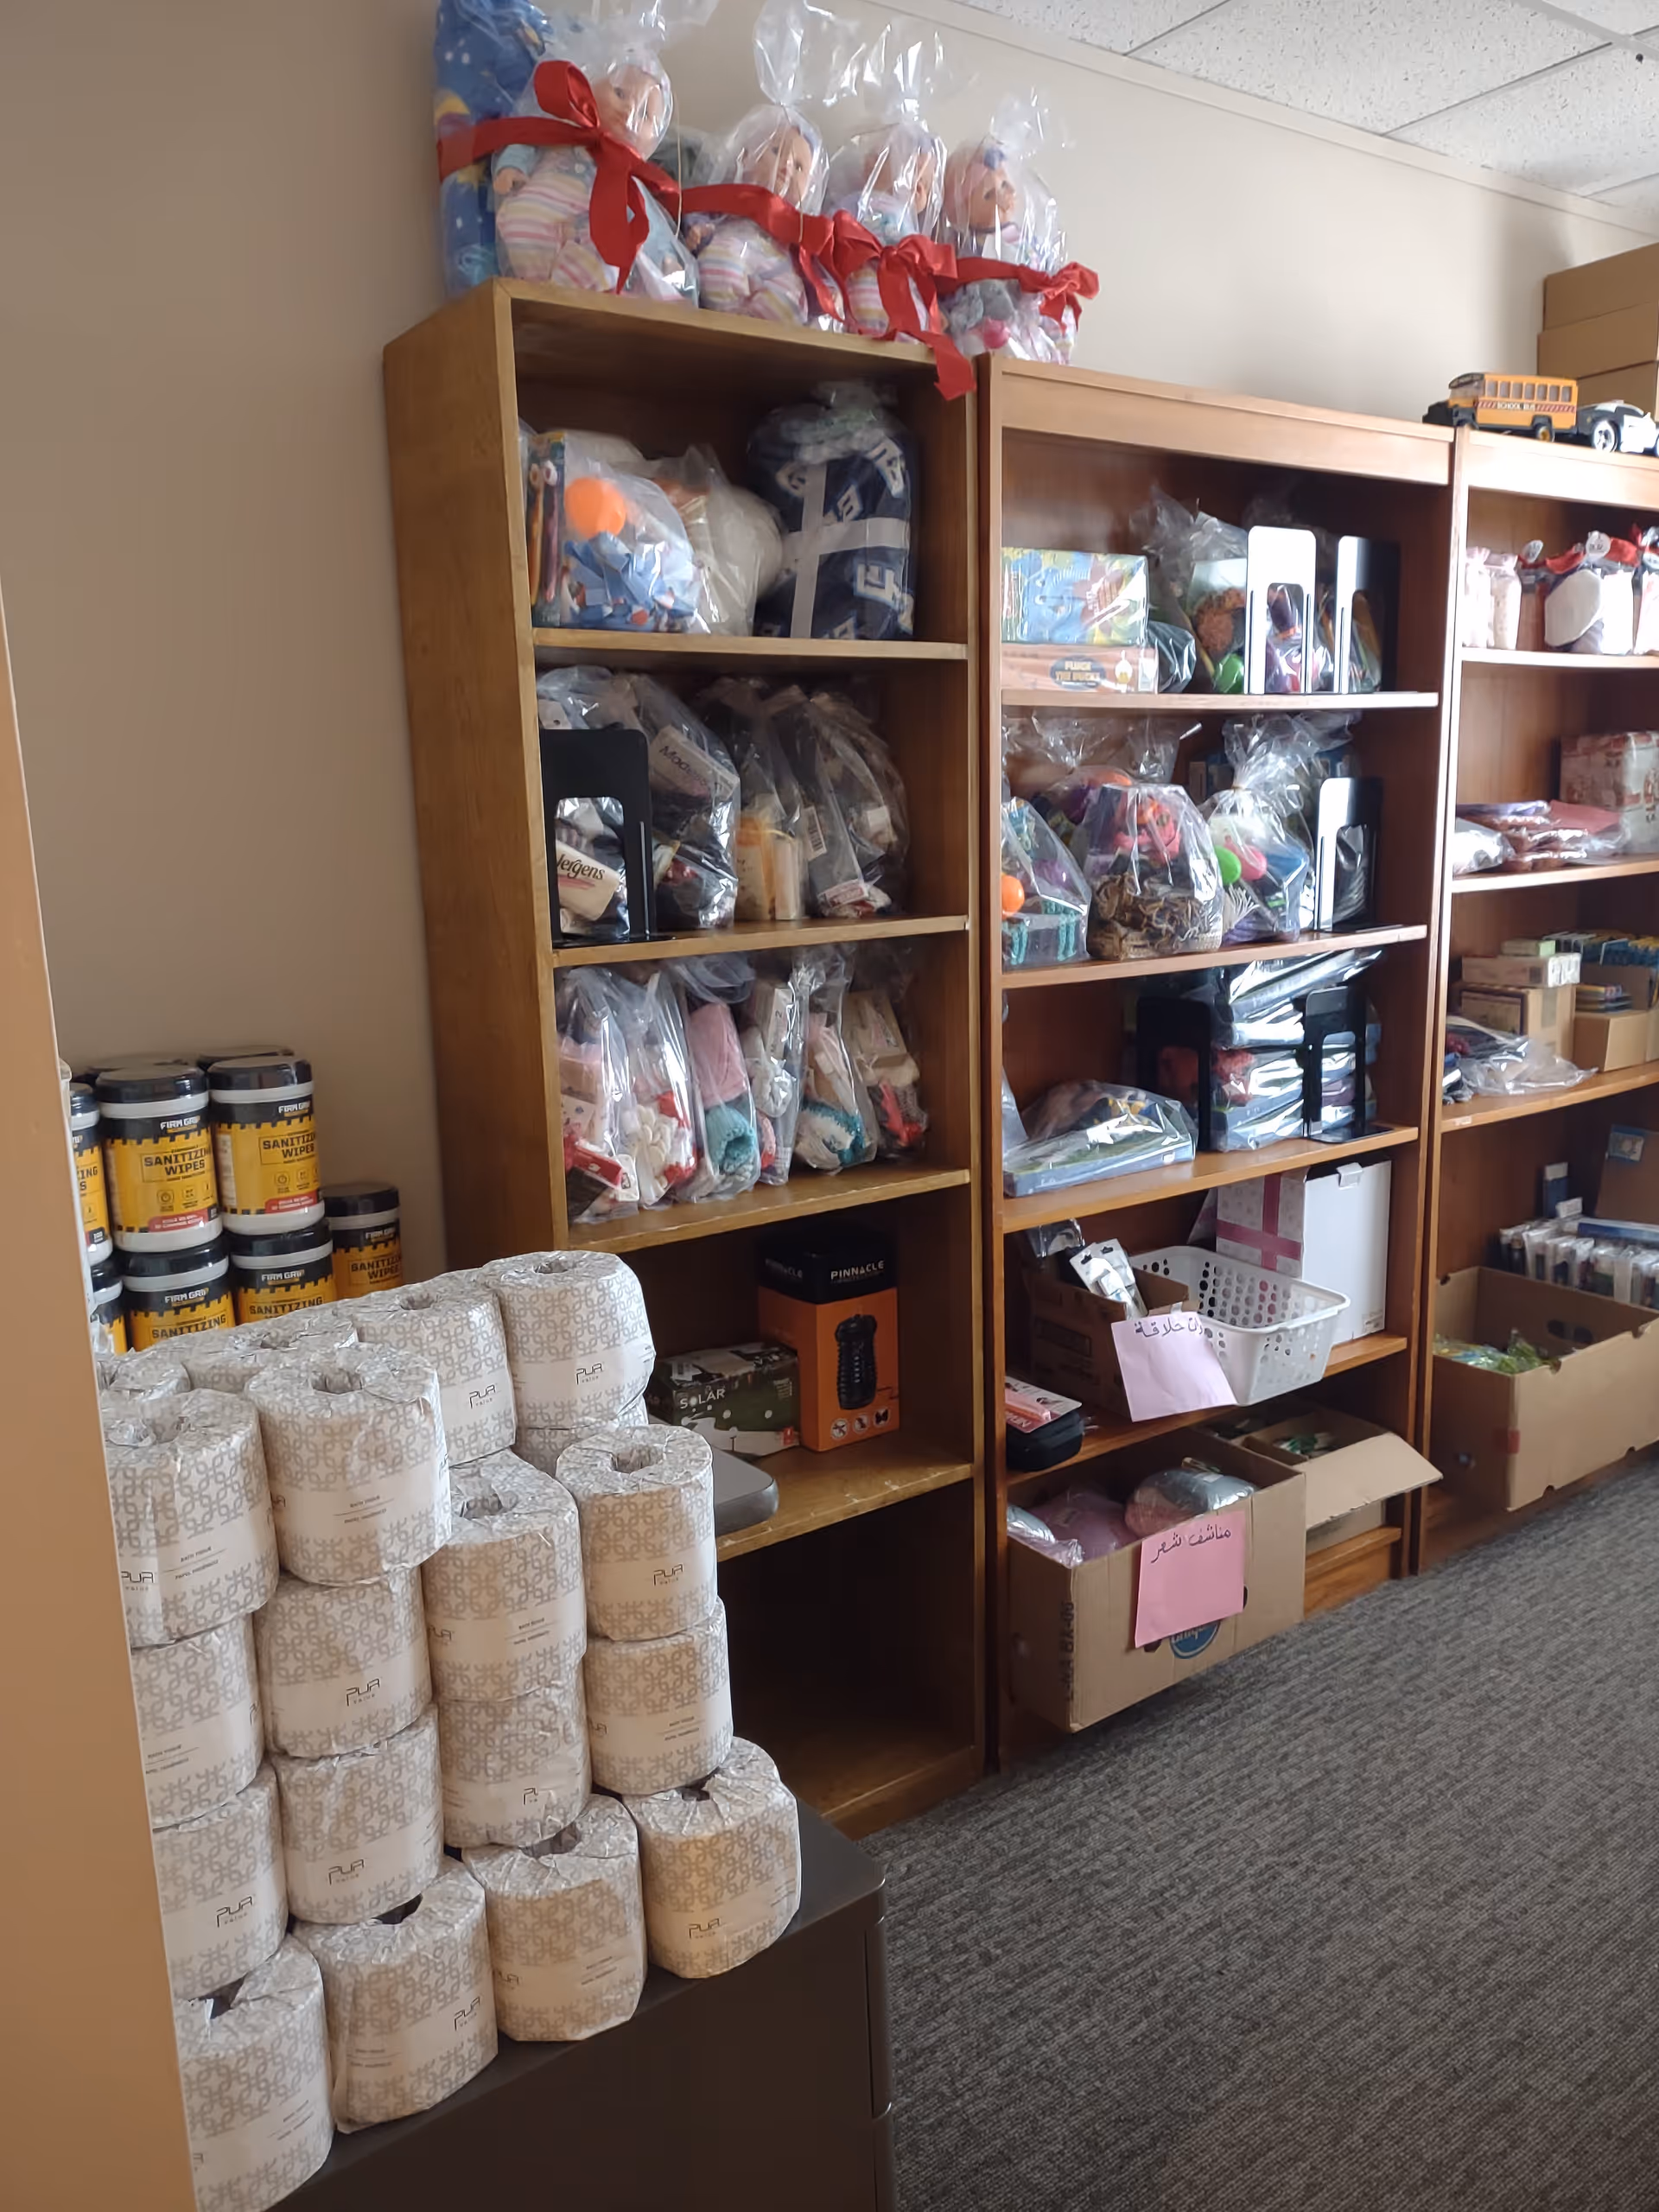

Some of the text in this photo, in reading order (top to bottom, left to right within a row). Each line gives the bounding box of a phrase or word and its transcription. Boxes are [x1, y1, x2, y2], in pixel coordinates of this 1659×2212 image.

[557, 854, 606, 880] Jergens
[278, 1102, 299, 1114] FIRM
[160, 1118, 183, 1131] FIRM
[263, 1132, 316, 1150] SANITIZI
[143, 1146, 212, 1166] SANITIZIN
[282, 1142, 315, 1159] WIPES
[164, 1159, 206, 1176] WIPES
[261, 1271, 283, 1281] FIRM
[830, 1260, 886, 1280] PINNACLE
[164, 1291, 188, 1304] FIRM
[249, 1296, 323, 1315] SANITIZING
[151, 1314, 226, 1339] SANITIZING
[679, 1388, 726, 1410] SOLAR
